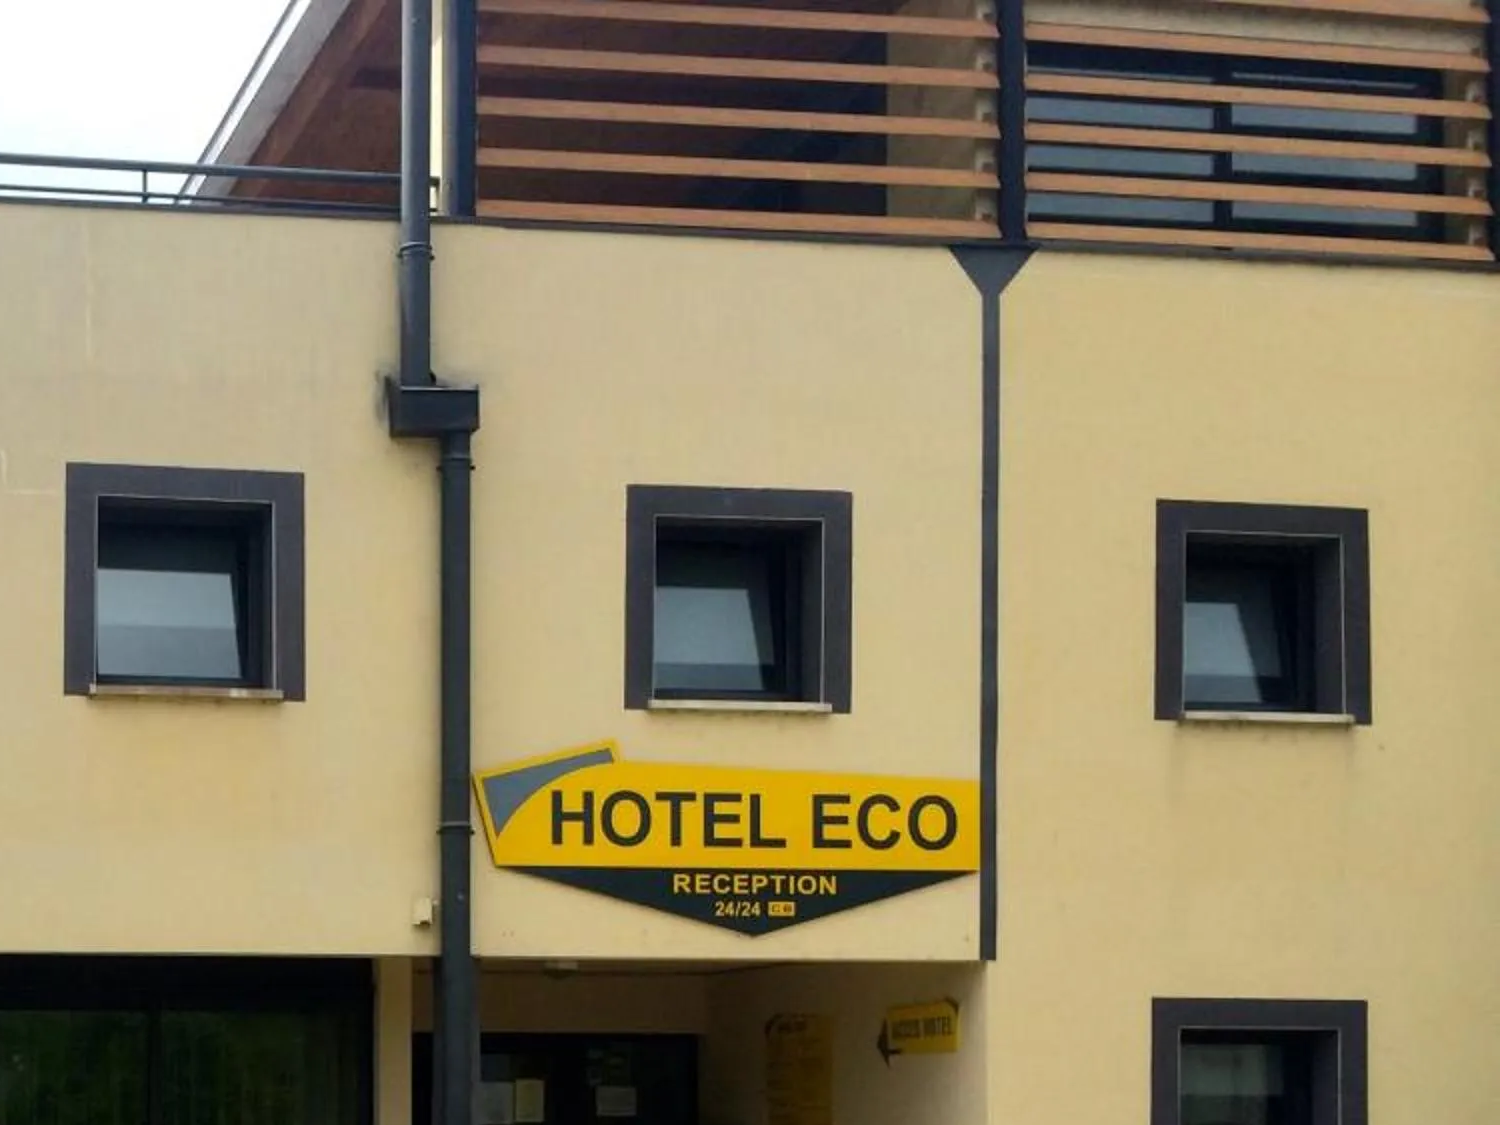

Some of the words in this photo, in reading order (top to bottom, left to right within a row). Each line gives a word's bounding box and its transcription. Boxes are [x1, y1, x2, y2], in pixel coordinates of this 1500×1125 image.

[551, 789, 787, 849] HOTEL
[813, 793, 958, 851] ECO
[673, 873, 837, 895] RECEPTION
[715, 901, 761, 917] 24/24
